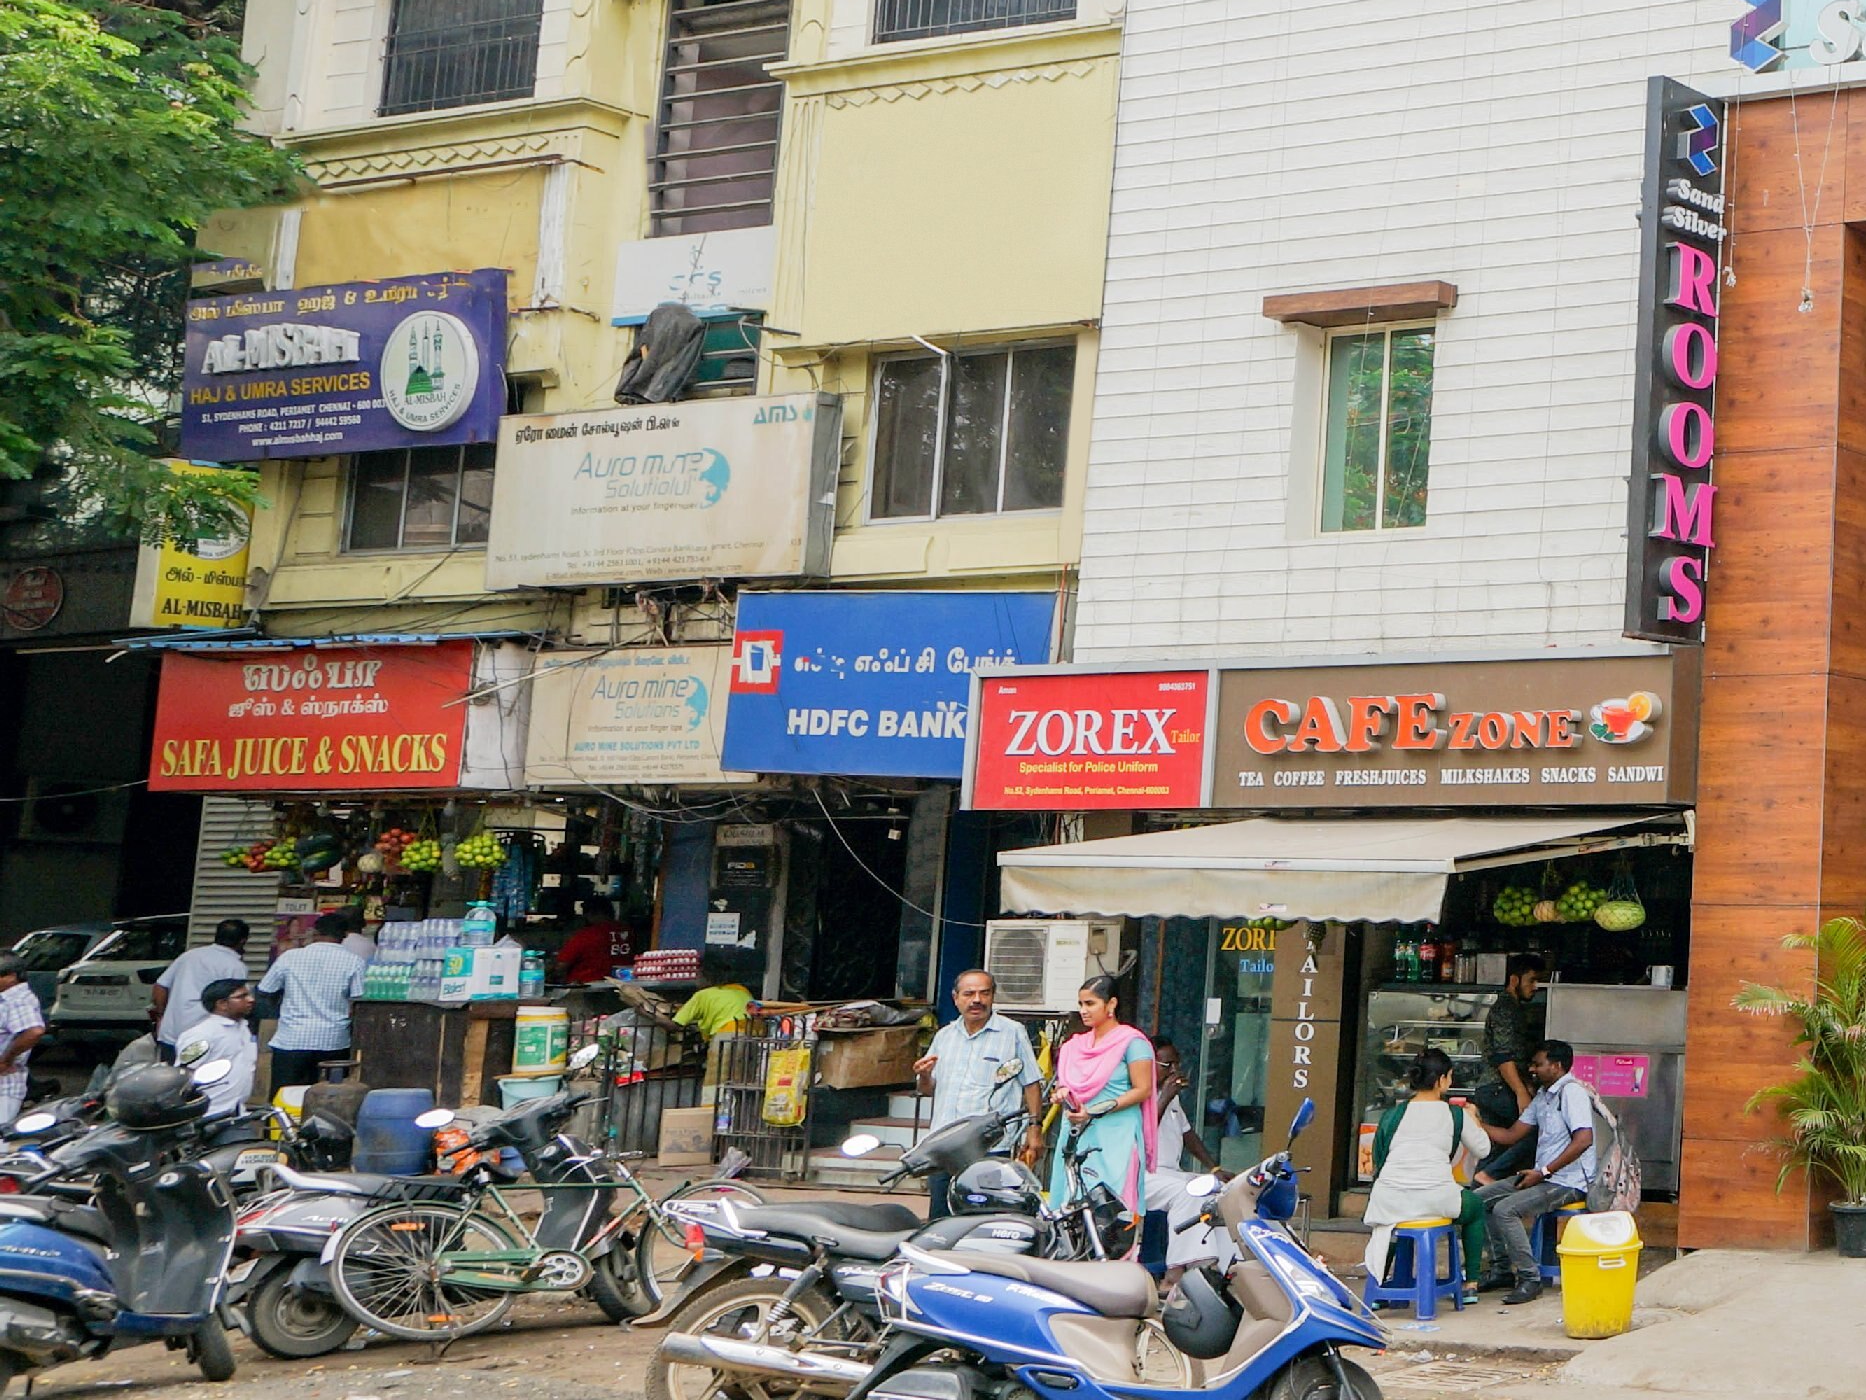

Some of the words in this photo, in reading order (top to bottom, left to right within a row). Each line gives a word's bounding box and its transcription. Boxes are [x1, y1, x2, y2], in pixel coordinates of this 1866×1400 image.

[1671, 178, 1725, 213] Sand
[1668, 206, 1727, 241] Silver
[190, 388, 221, 404] HAJ
[226, 386, 236, 401] &
[240, 379, 287, 401] UMRA
[290, 372, 371, 396] SERVICES
[1650, 241, 1719, 624] ROOMS
[574, 451, 636, 481] Auro
[165, 566, 194, 583] அல்
[161, 599, 243, 620] AL-MISBAH
[591, 675, 639, 699] Auro
[642, 672, 690, 698] mine
[280, 700, 295, 716] &
[787, 708, 869, 737] HDFC
[877, 709, 967, 739] BANK
[1004, 708, 1177, 756] ZOREX
[1171, 729, 1201, 743] Tailor
[1243, 692, 1445, 756] CAFE
[1448, 708, 1583, 751] ZONE
[160, 740, 222, 777] SAFA
[227, 737, 308, 780] JUICE
[313, 734, 333, 774] &
[339, 733, 448, 774] SNACKS
[620, 740, 664, 750] SOLUTIONS
[684, 740, 700, 749] LTD
[1019, 761, 1067, 775] Specialist
[1069, 761, 1083, 773] for
[1085, 761, 1115, 773] Police
[1117, 761, 1158, 773] Uniform
[1239, 770, 1264, 787] TEA
[1273, 769, 1325, 786] COFFEE
[1334, 768, 1427, 786] FRESHJUICES
[1440, 767, 1531, 784] MILKSHAKES
[1541, 766, 1597, 783] SNACKS
[1608, 765, 1665, 783] SANDWI
